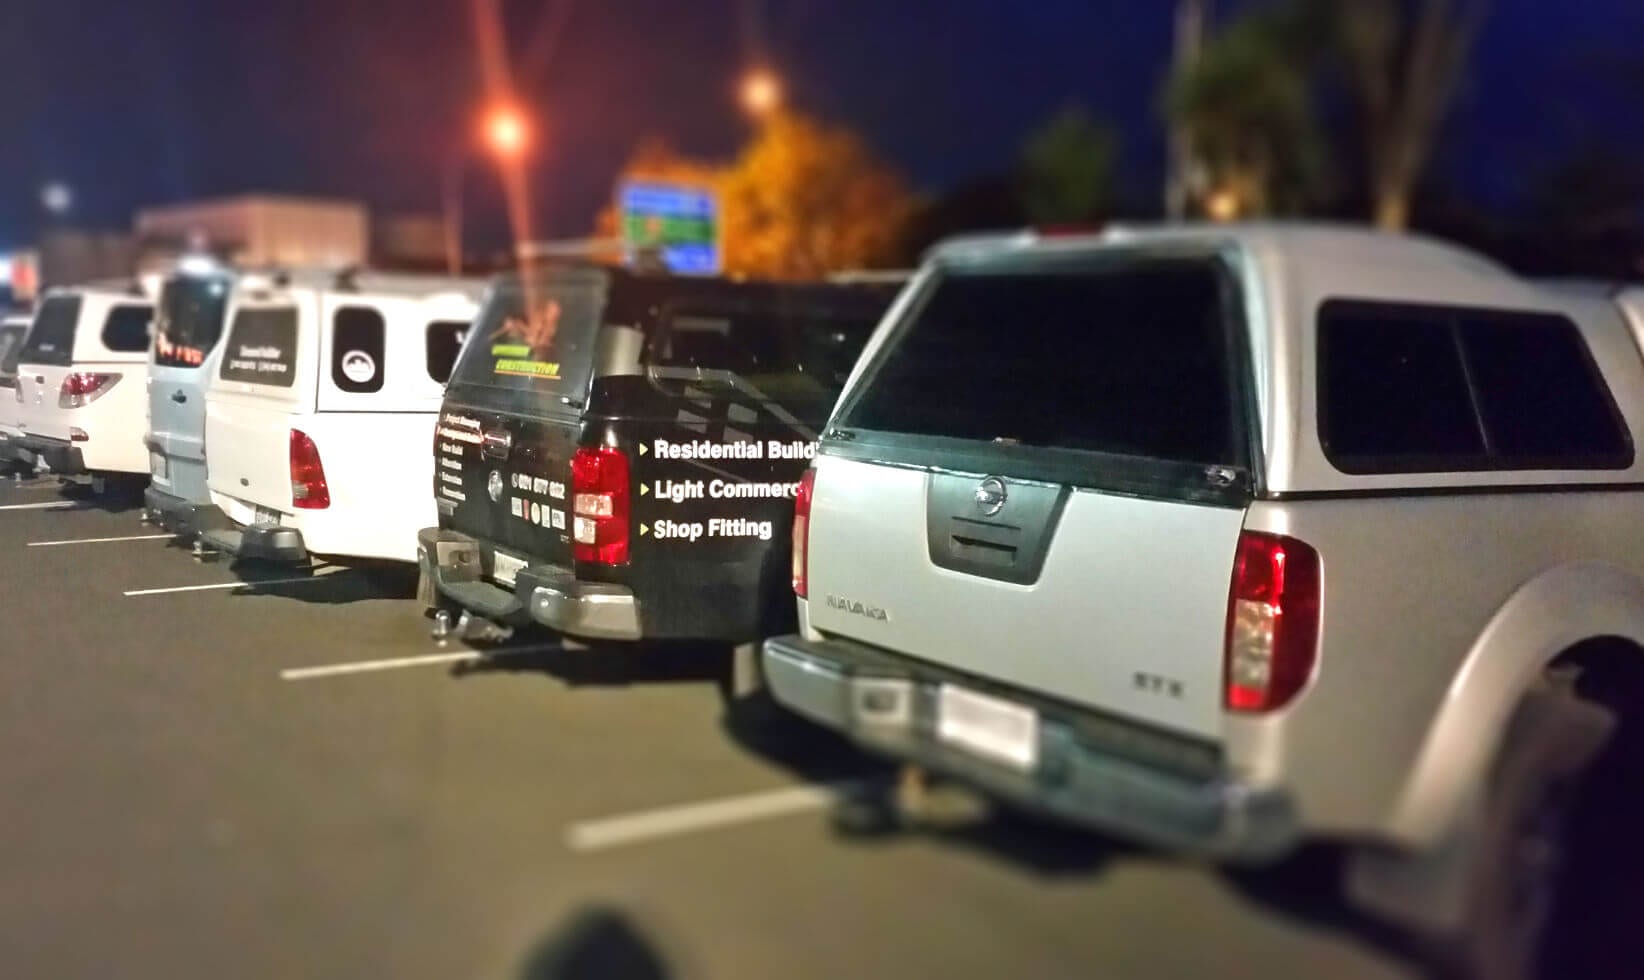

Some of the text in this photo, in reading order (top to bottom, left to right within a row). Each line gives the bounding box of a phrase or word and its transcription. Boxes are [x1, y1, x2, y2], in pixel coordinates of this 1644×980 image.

[654, 439, 819, 459] Residential Build
[655, 480, 704, 503] Light
[654, 518, 772, 542] Shop Fitting
